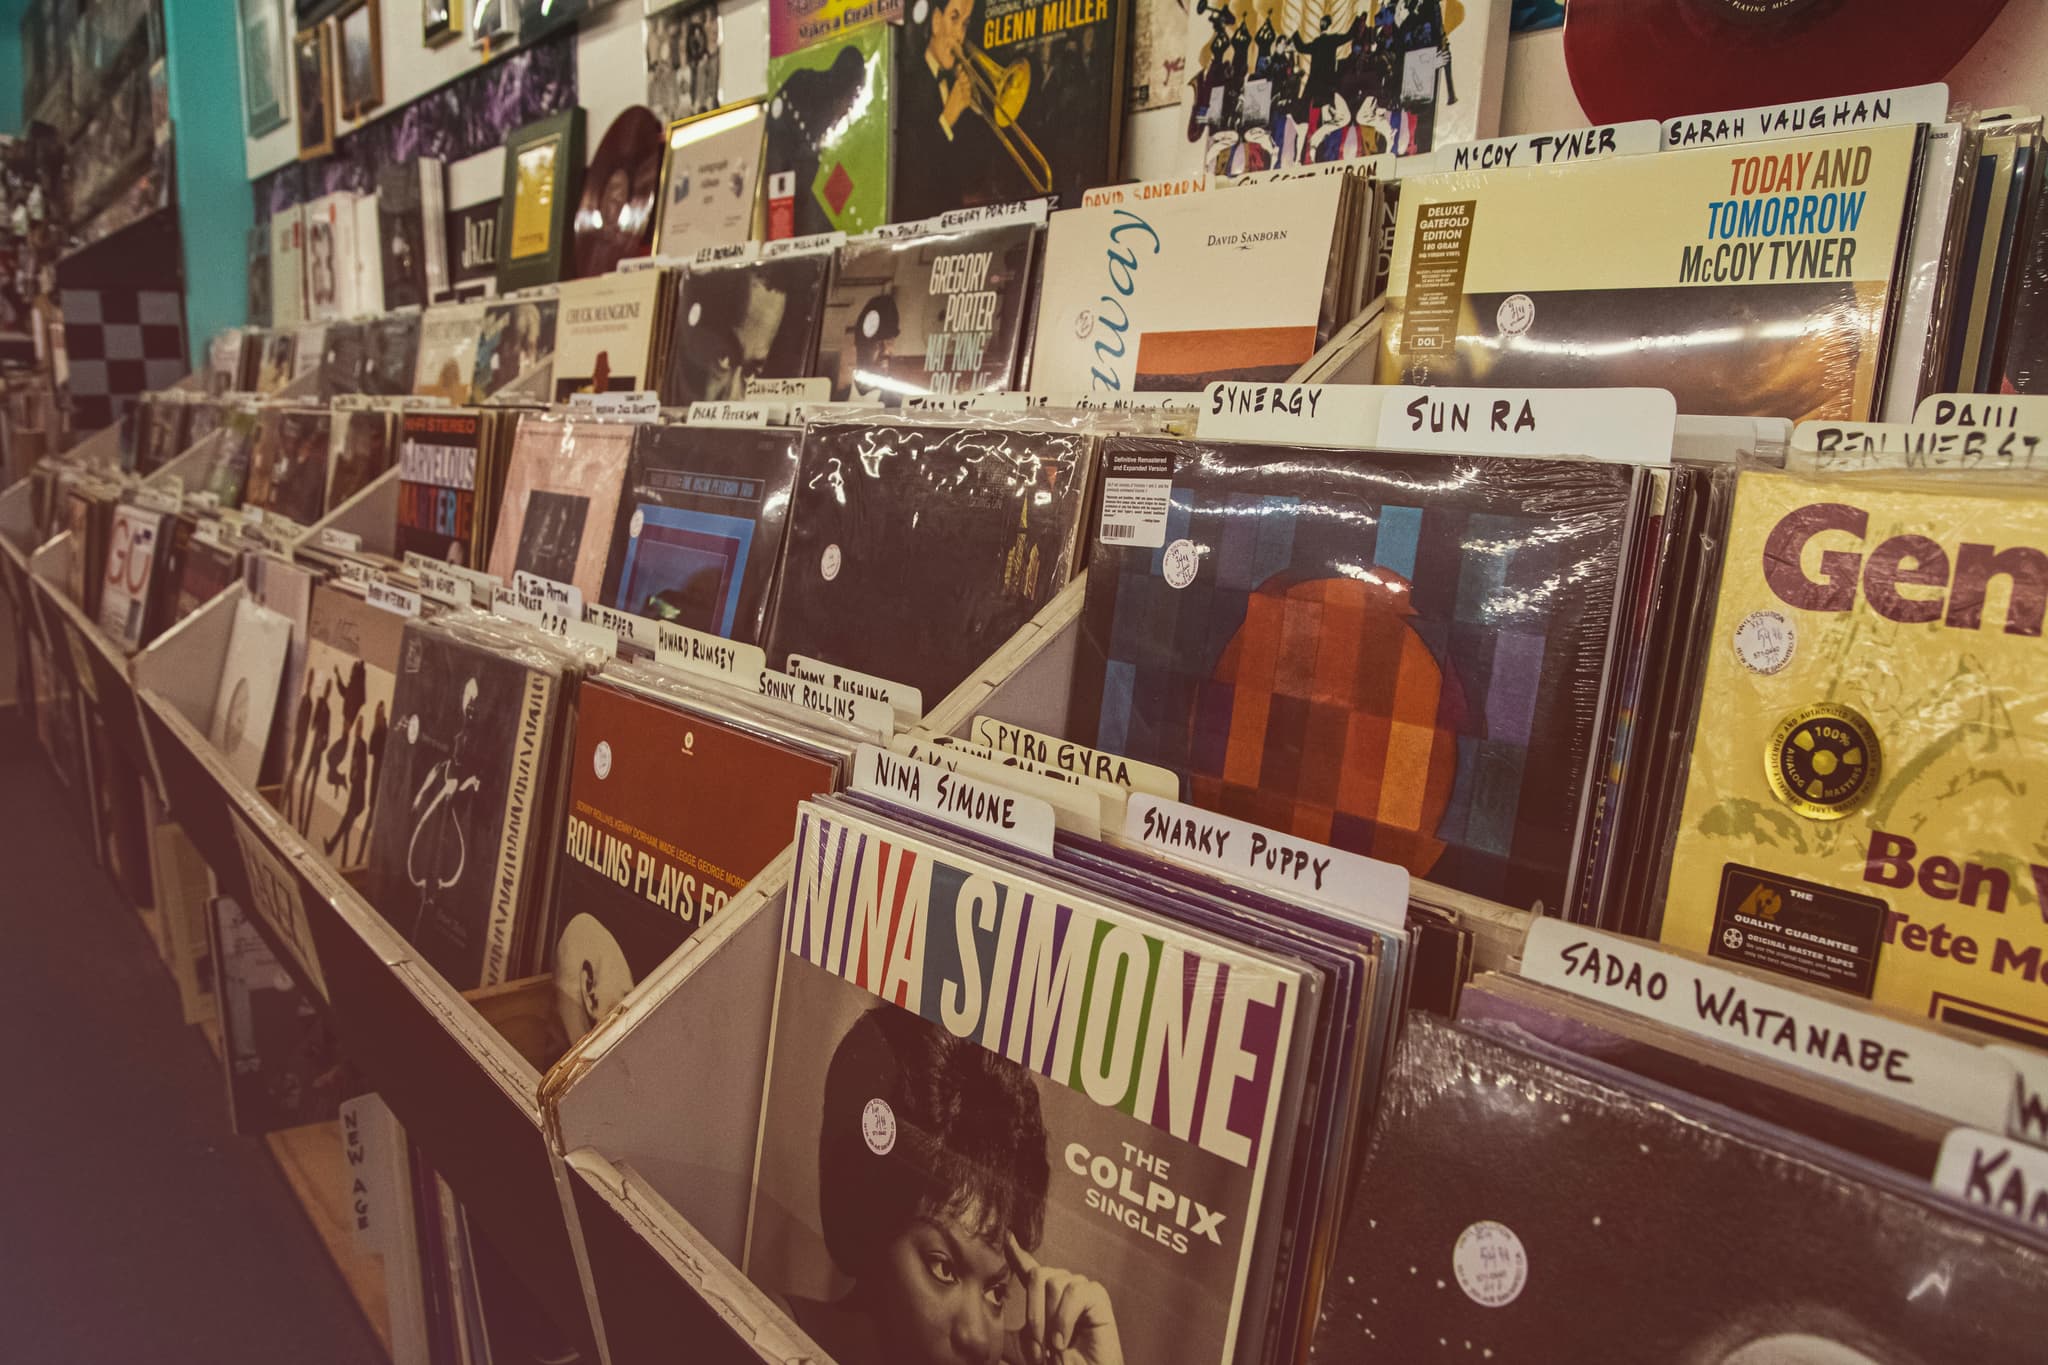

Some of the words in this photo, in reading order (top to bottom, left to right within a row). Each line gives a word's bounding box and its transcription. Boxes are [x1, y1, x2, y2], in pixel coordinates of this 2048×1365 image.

[984, 9, 1037, 49] GLENN
[1042, 0, 1109, 34] MILLER
[1669, 117, 1745, 146] SARAH
[1760, 97, 1891, 135] VAUGHAN
[1530, 127, 1617, 164] TYNER
[1729, 151, 1813, 197] TODAY
[1811, 145, 1873, 190] AND
[940, 212, 982, 229] GREGORY
[984, 200, 1027, 220] PORTER
[1085, 191, 1124, 207] DAVID
[1427, 205, 1465, 218] DELUXE
[1707, 190, 1867, 240] TOMORROW
[1419, 217, 1470, 230] GATEFOLD
[1422, 229, 1463, 242] EDITION
[929, 252, 993, 295] GREGORY
[1768, 237, 1856, 279] TYNER
[943, 291, 997, 332] PORTER
[923, 334, 950, 371] NAT
[1417, 337, 1436, 346] DOL
[723, 404, 760, 422] PETERSON
[1212, 385, 1323, 417] SYNERGY
[1407, 397, 1470, 433] SUN
[1491, 401, 1537, 432] RA
[1816, 427, 1888, 470] BEN
[1763, 502, 2048, 638] Gen
[603, 611, 634, 639] PEPPER
[658, 628, 689, 652] HOWARD
[691, 637, 735, 672] RUMSEY
[759, 671, 795, 699] SONNY
[802, 688, 855, 722] ROLLINS
[832, 674, 889, 703] RUSHING
[980, 719, 1047, 762] SPYRO
[1057, 744, 1132, 787] GYRA
[1815, 726, 1850, 746] 100%
[1785, 747, 1805, 788] ANALOG
[1824, 767, 1862, 797] MASTERS
[875, 752, 920, 802] NINA
[937, 774, 1016, 829] SIMONE
[1143, 806, 1231, 857] SNARKY
[567, 815, 633, 888] ROLLINS
[634, 850, 696, 921] PLAYS
[1864, 830, 2011, 913] Ben
[1790, 889, 1813, 901] THE
[1734, 914, 1782, 933] QUALITY
[1785, 928, 1859, 954] GUARANTEE
[1747, 934, 1786, 951] ORIGINAL
[1788, 944, 1824, 961] MASTER
[1826, 954, 1854, 969] TAPES
[791, 812, 937, 1016] NINA
[939, 868, 1290, 1168] SIMONE
[1560, 942, 1667, 1001] SADAO
[1693, 979, 1914, 1083] WATANABE
[344, 1109, 365, 1167] NEW
[1121, 1142, 1171, 1180] THE
[352, 1177, 369, 1232] AGE
[1064, 1143, 1226, 1245] COLPIX
[1085, 1189, 1189, 1254] SINGLES
